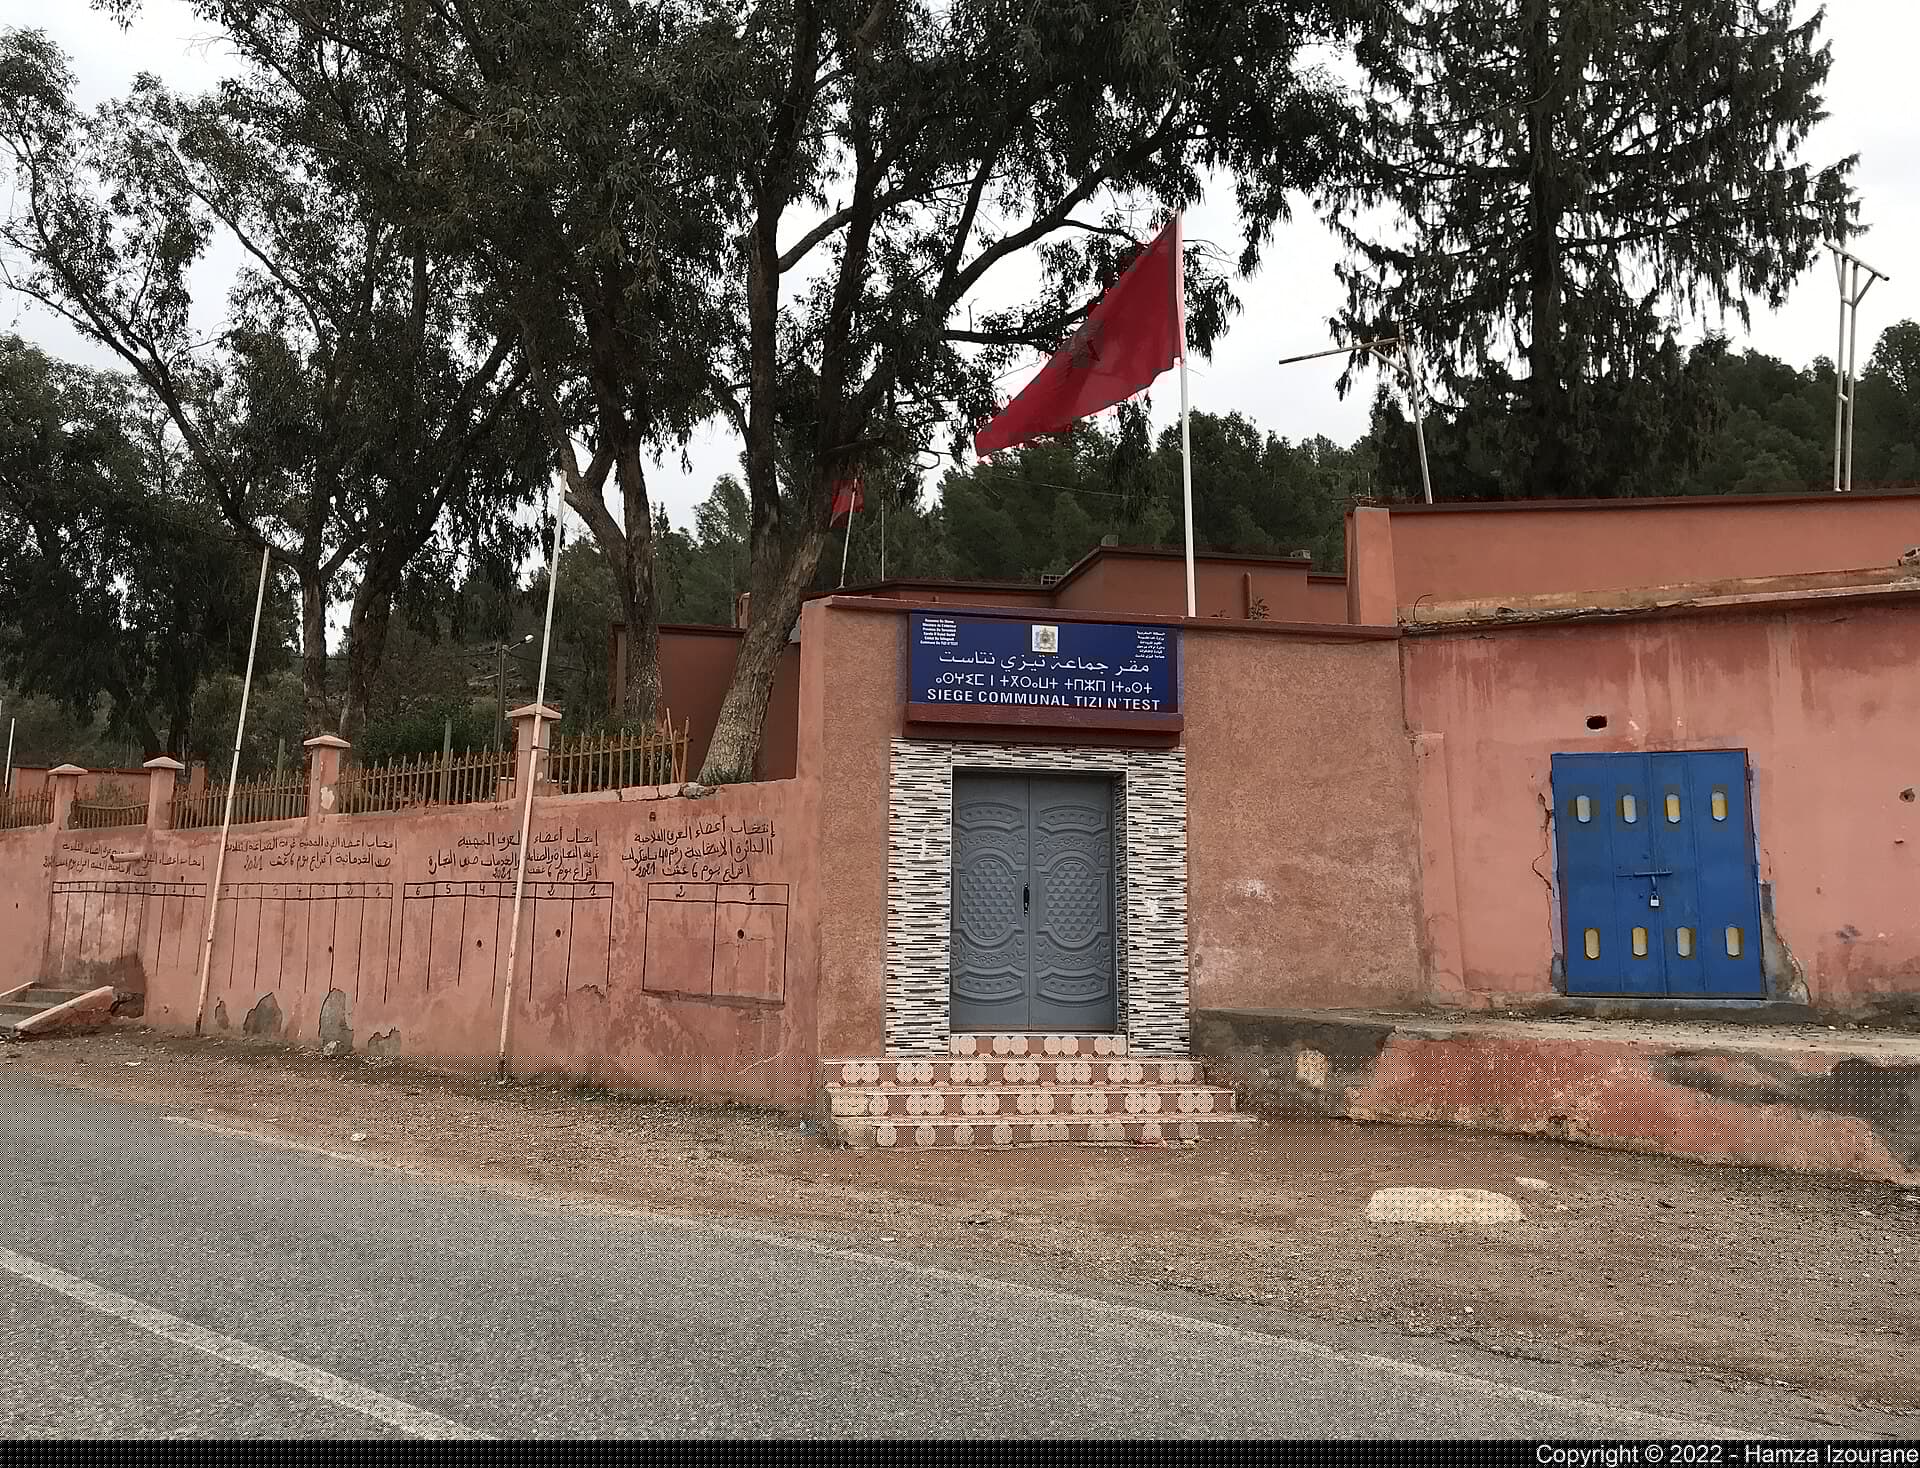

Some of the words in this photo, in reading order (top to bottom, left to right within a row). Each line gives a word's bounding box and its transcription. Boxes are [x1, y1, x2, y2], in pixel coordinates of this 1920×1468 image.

[1000, 654, 1046, 672] تيزي
[1050, 656, 1108, 674] جماعة
[1115, 660, 1149, 676] مقر
[927, 688, 973, 702] SIEGE
[978, 691, 1069, 706] COMMUNAL
[1074, 696, 1102, 708] TIZI
[748, 887, 757, 901] 1
